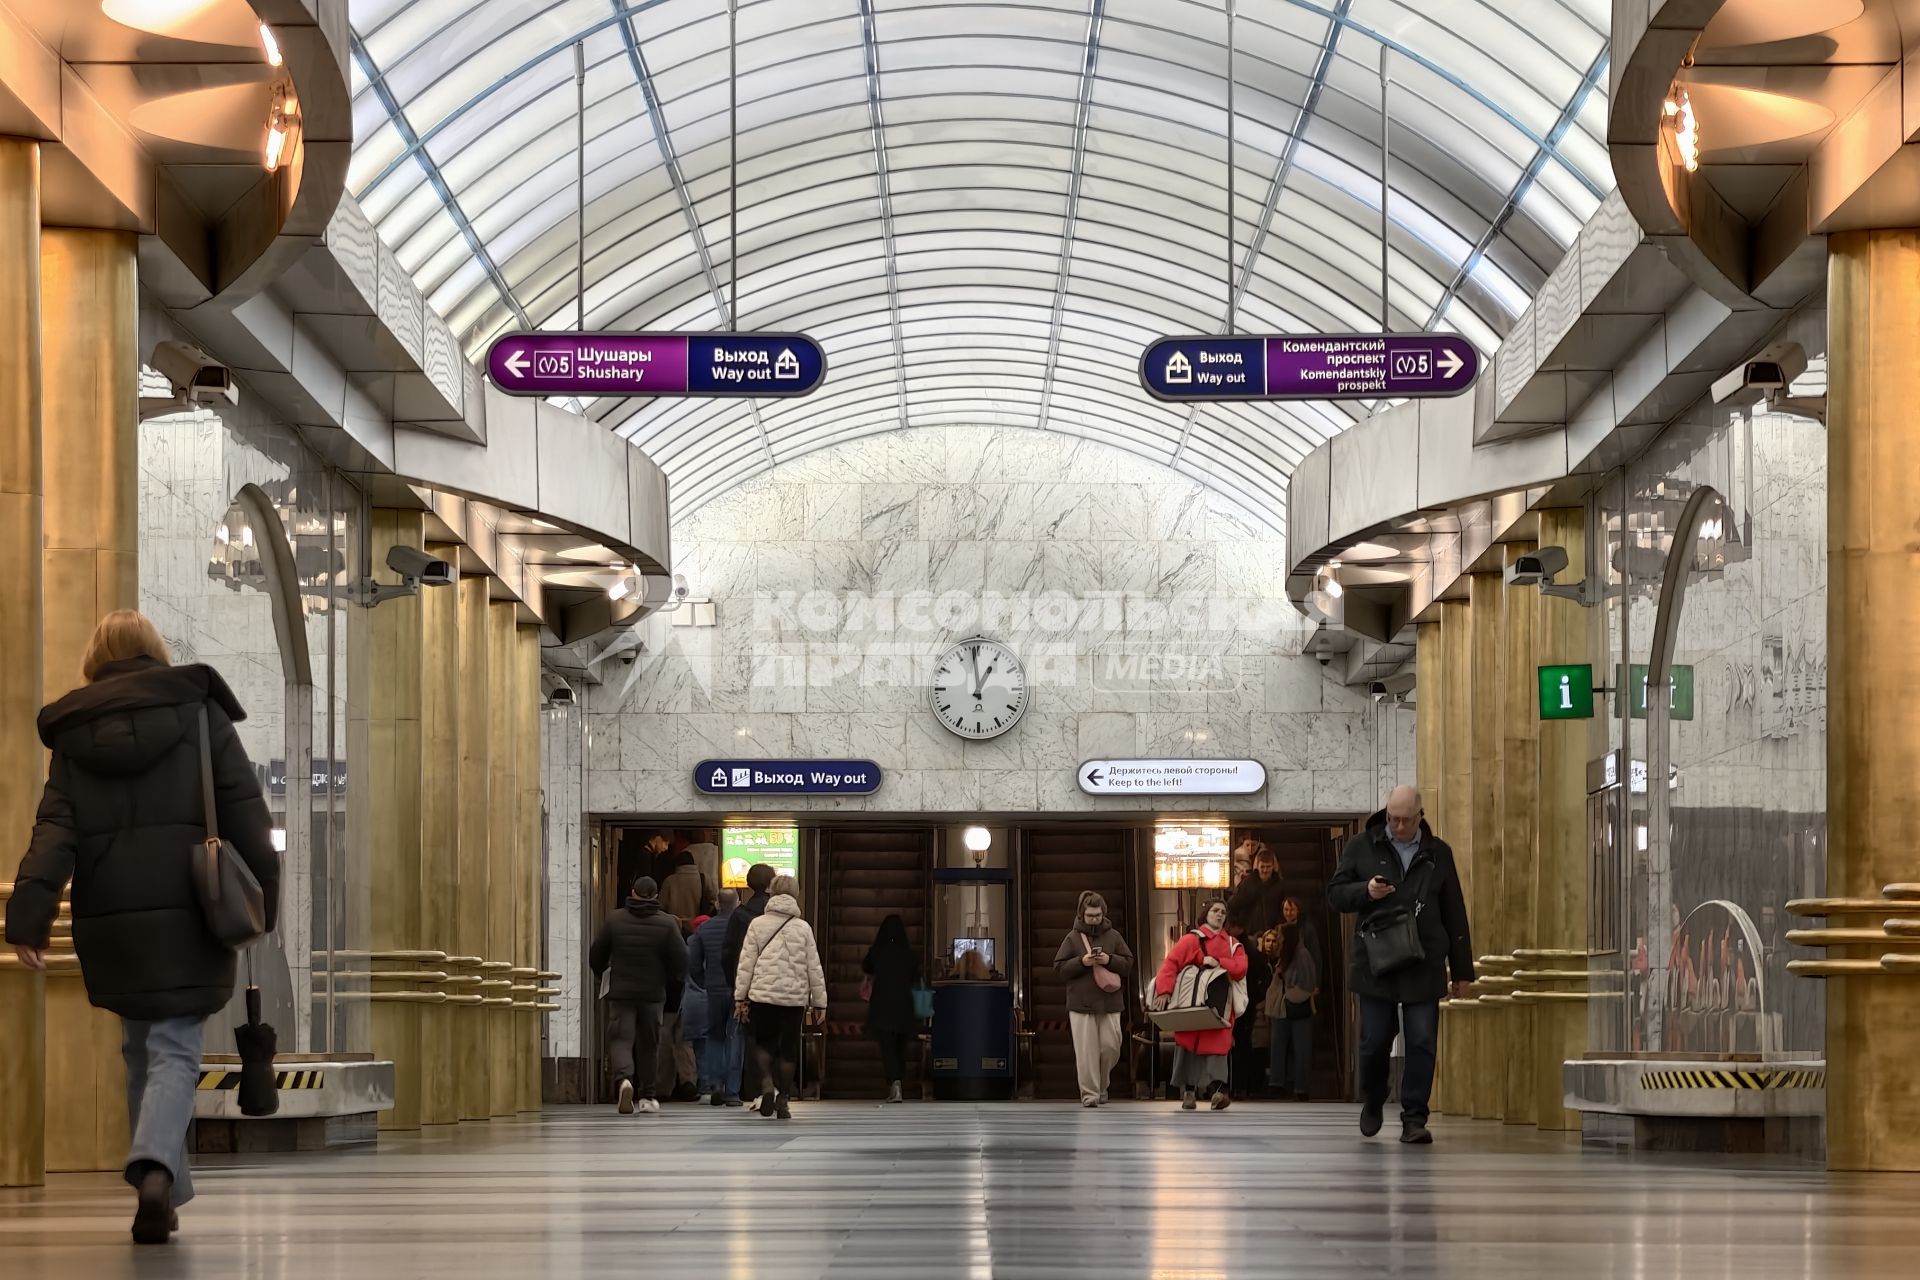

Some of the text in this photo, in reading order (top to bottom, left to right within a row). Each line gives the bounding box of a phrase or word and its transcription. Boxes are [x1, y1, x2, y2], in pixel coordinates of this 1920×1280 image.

[1283, 339, 1386, 353] Комендантский
[577, 347, 652, 363] Шушары
[714, 348, 769, 364] Выход
[1199, 351, 1243, 365] Выход
[1327, 354, 1386, 366] проспект
[577, 365, 644, 382] Shushary
[712, 366, 772, 383] Way out
[1197, 372, 1246, 386] Way out
[1300, 368, 1387, 382] Komendantskiy
[1337, 379, 1387, 393] prospekt
[1109, 765, 1238, 776] Держитесь левой стороны!
[754, 771, 867, 787] Выход Way out
[1108, 777, 1182, 789] Keep to the left!
